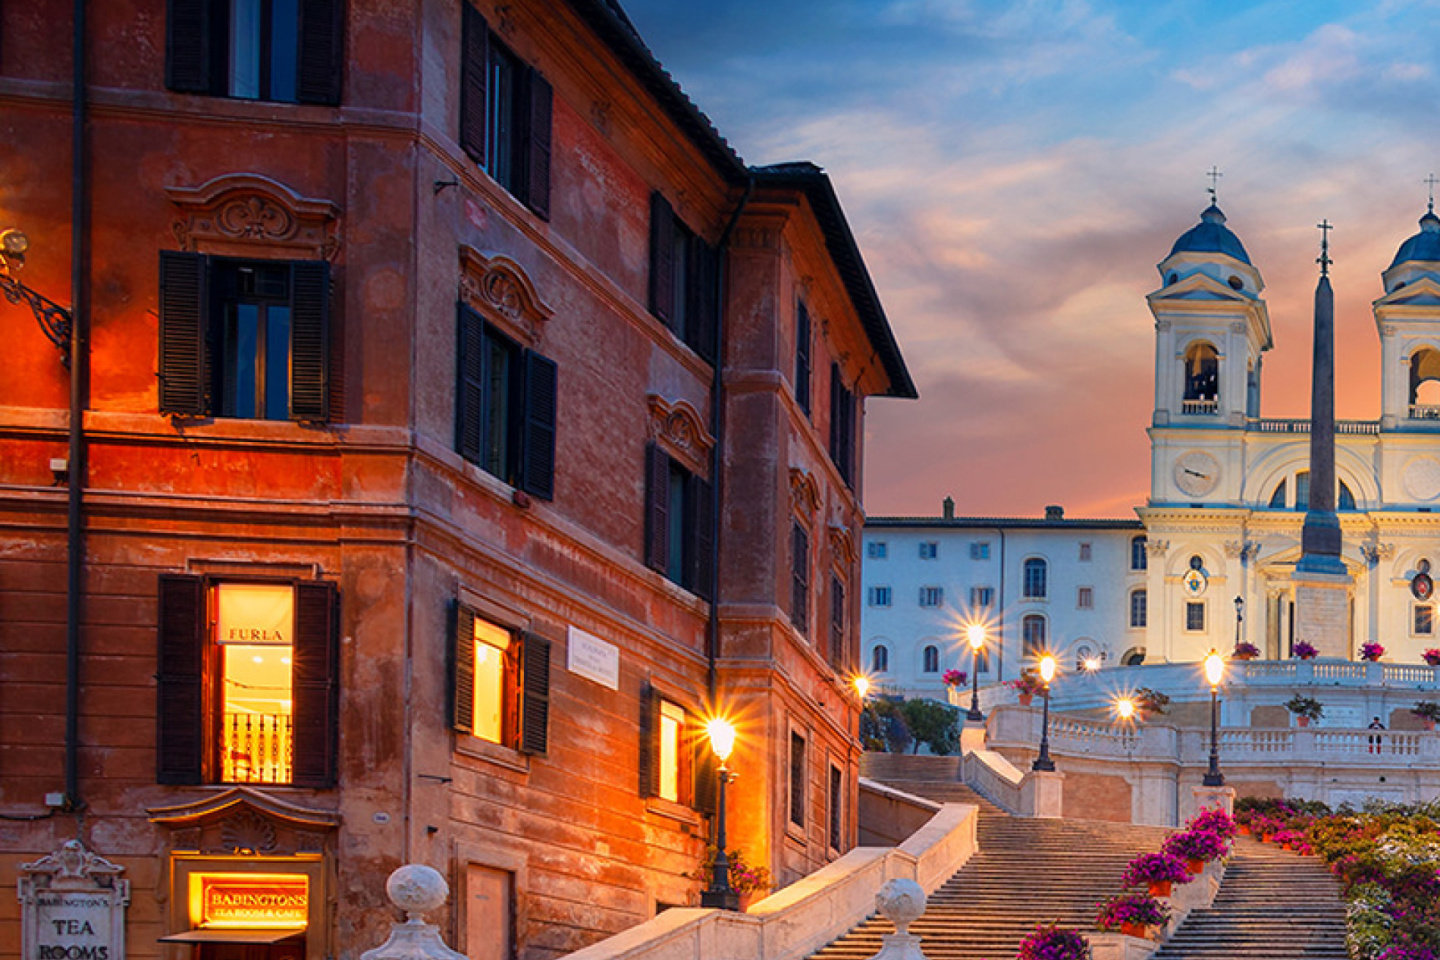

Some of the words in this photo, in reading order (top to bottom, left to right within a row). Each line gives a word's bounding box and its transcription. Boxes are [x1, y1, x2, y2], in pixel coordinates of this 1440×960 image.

[229, 629, 283, 641] FURLA
[212, 894, 307, 906] BABINGTONS
[52, 919, 94, 935] TEA
[39, 945, 109, 960] ROOMS
